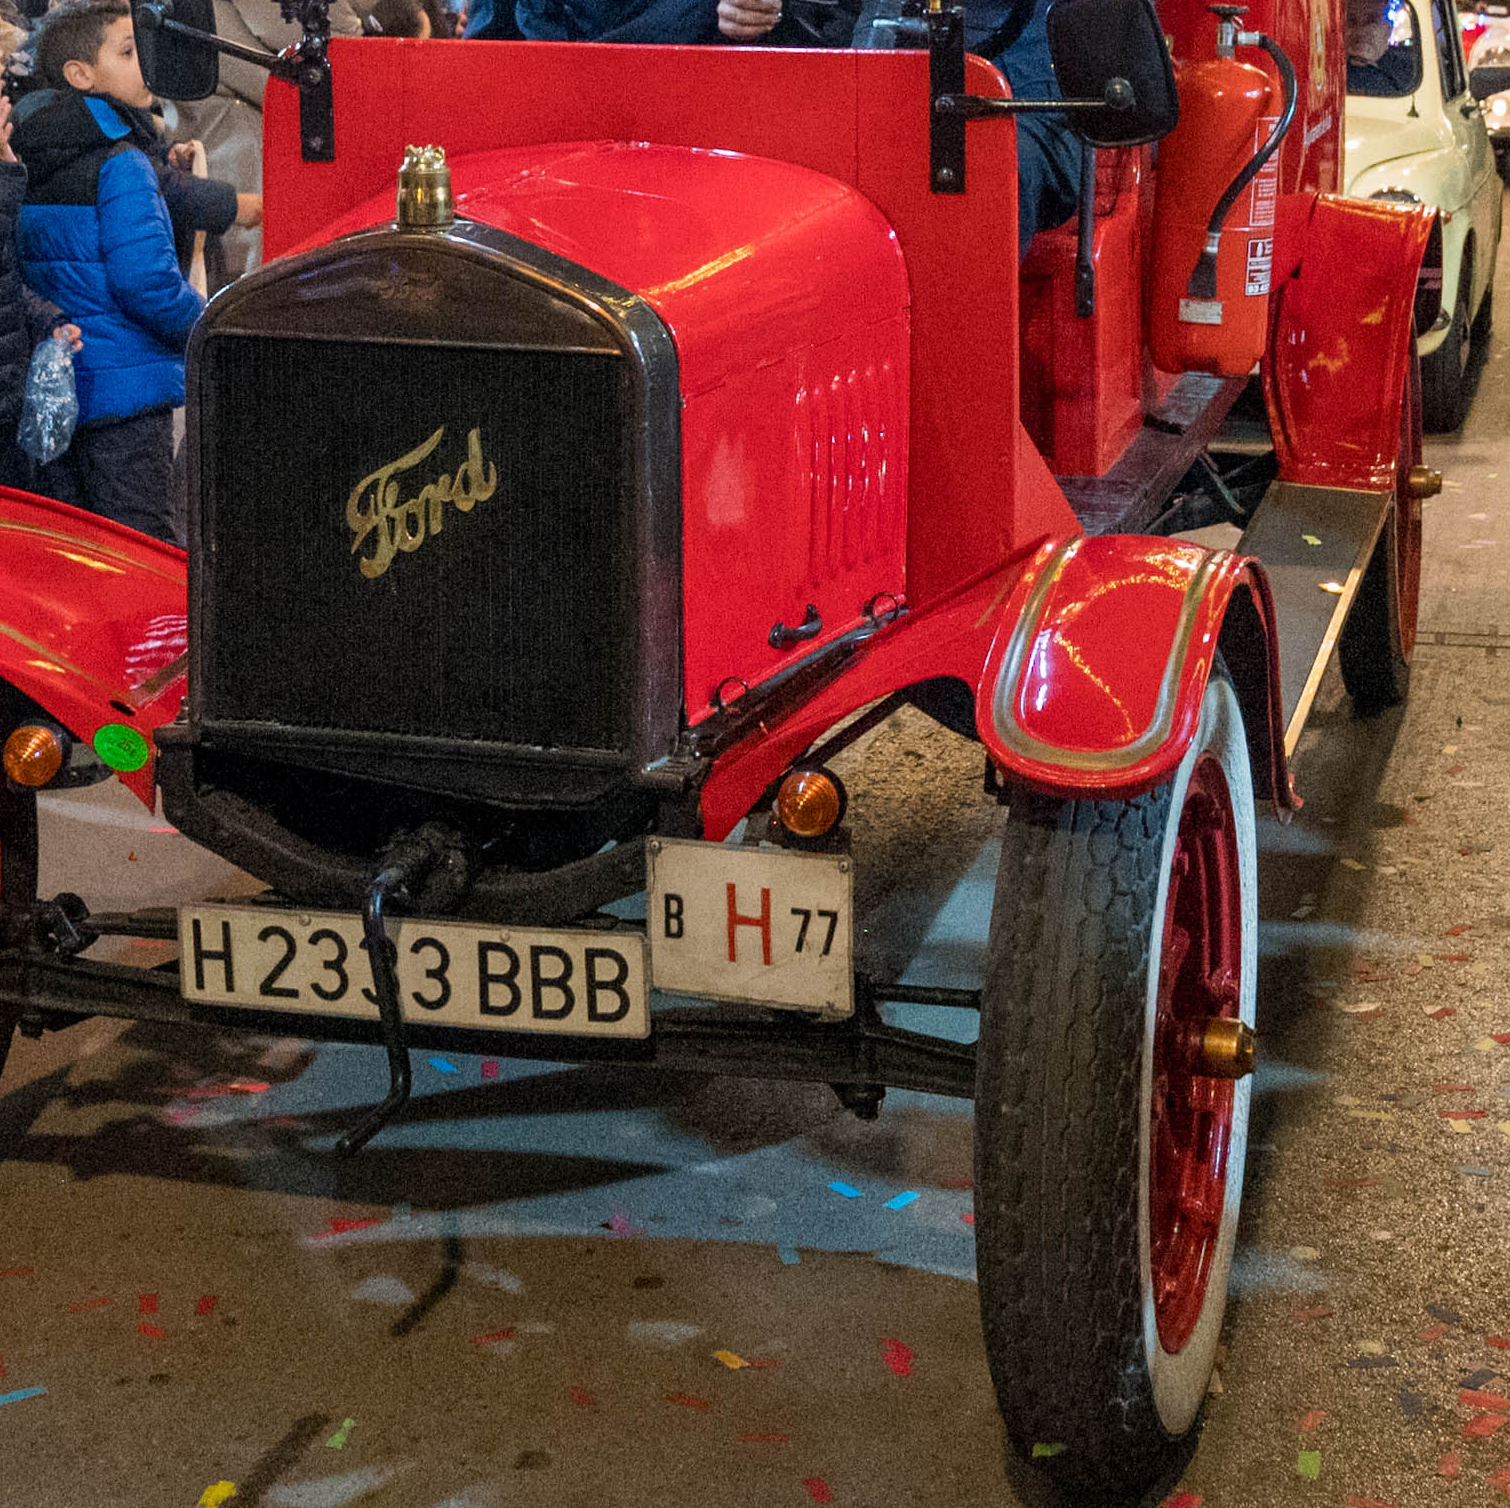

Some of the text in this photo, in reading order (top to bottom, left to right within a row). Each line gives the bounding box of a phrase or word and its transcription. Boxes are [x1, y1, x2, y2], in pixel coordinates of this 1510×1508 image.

[345, 426, 497, 579] Ford
[191, 918, 235, 994] H
[476, 939, 632, 1024] BBB
[663, 882, 840, 967] B H 77
